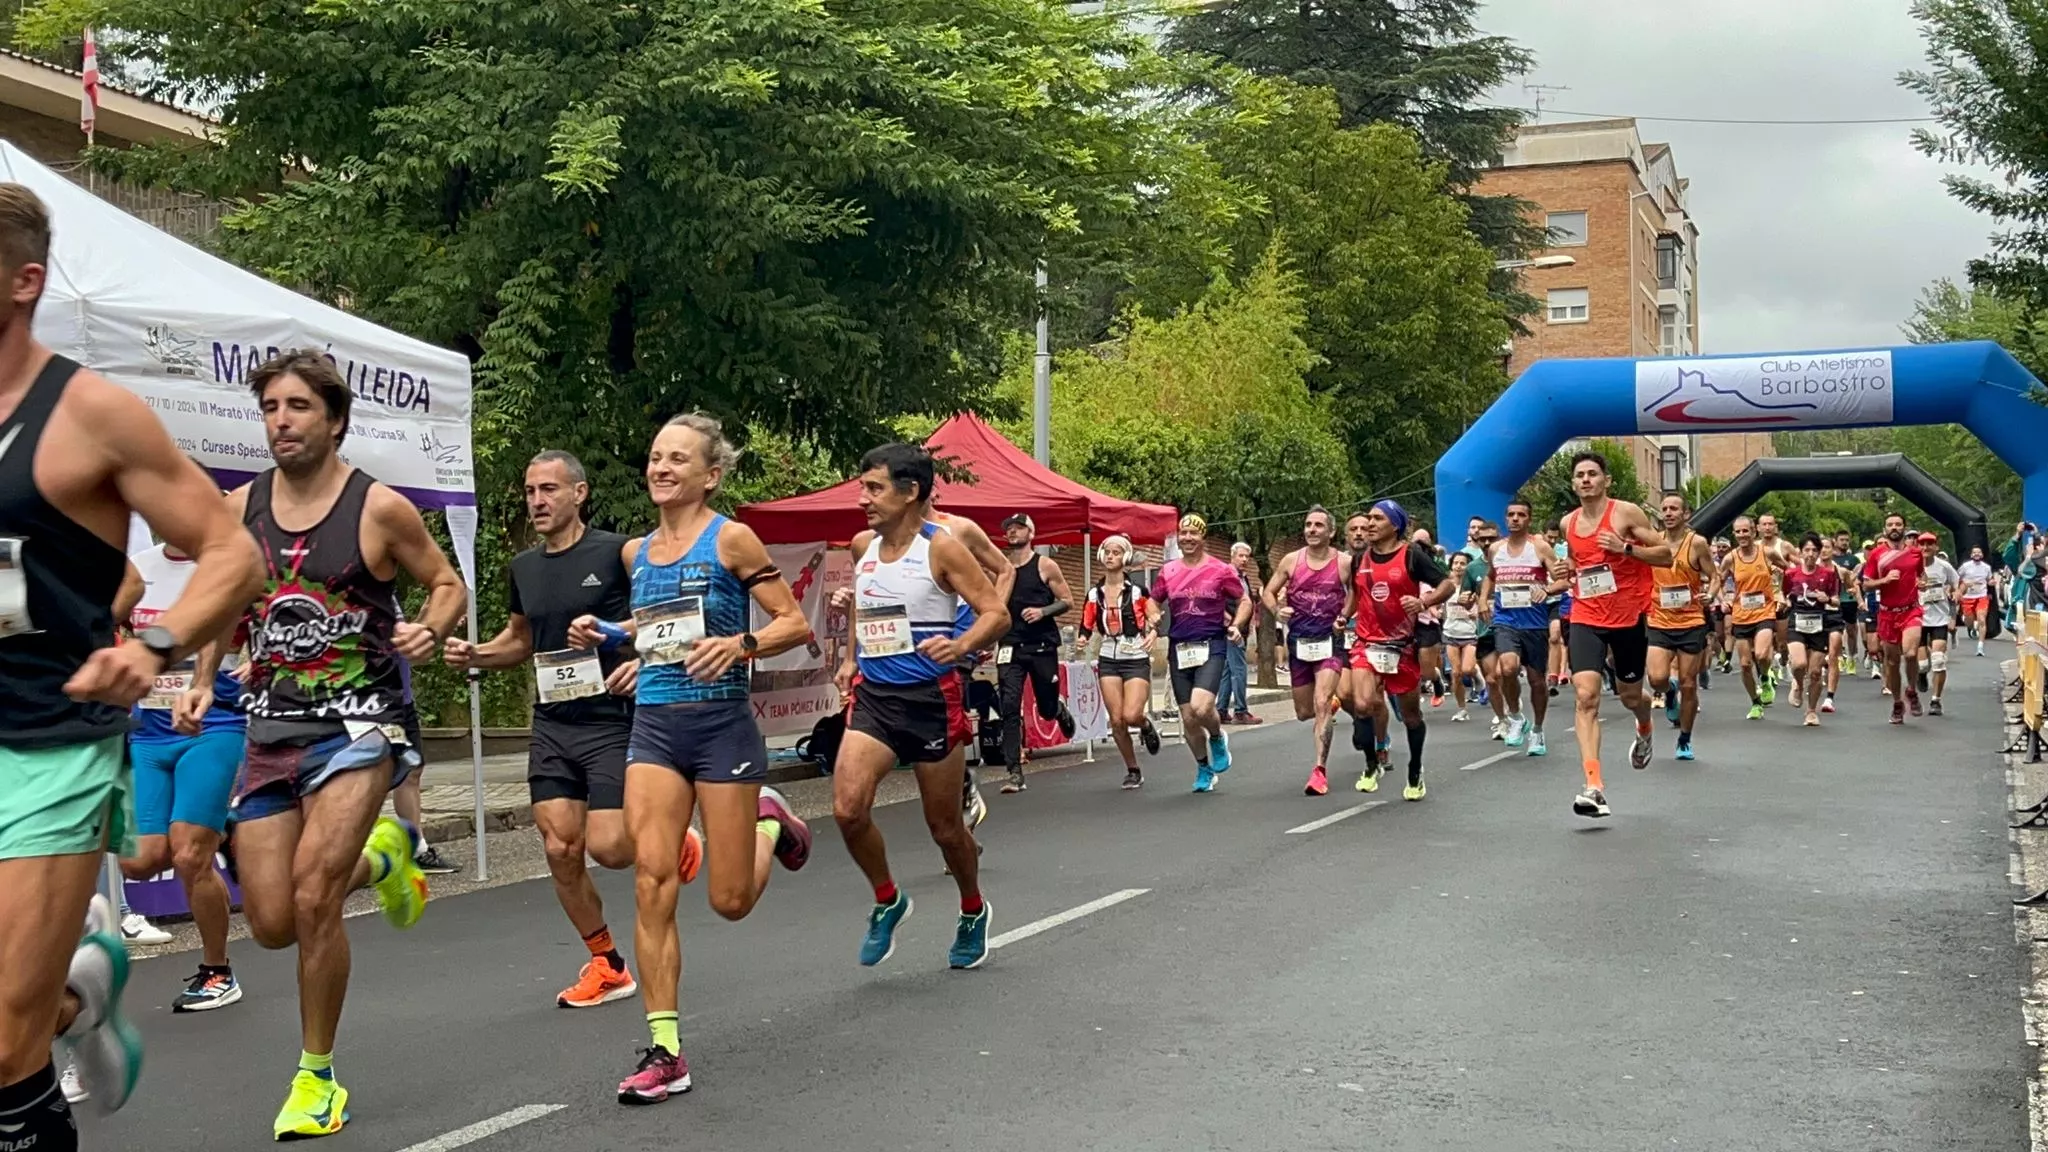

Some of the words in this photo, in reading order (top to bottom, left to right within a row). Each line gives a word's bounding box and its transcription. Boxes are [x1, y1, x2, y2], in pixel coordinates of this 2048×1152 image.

[1760, 359, 1802, 374] Club
[1806, 356, 1885, 372] Atletismo
[345, 360, 430, 413] LLEIDA
[1761, 372, 1886, 396] Barbastro
[177, 400, 197, 414] 2024
[209, 403, 243, 420] Marató
[243, 407, 265, 423] Vith
[177, 438, 197, 451] 2024
[201, 439, 235, 456] Curses
[656, 622, 675, 639] 27
[863, 621, 896, 636] 1014
[556, 667, 576, 681] 52
[154, 677, 184, 690] 036
[769, 703, 790, 719] TEAM
